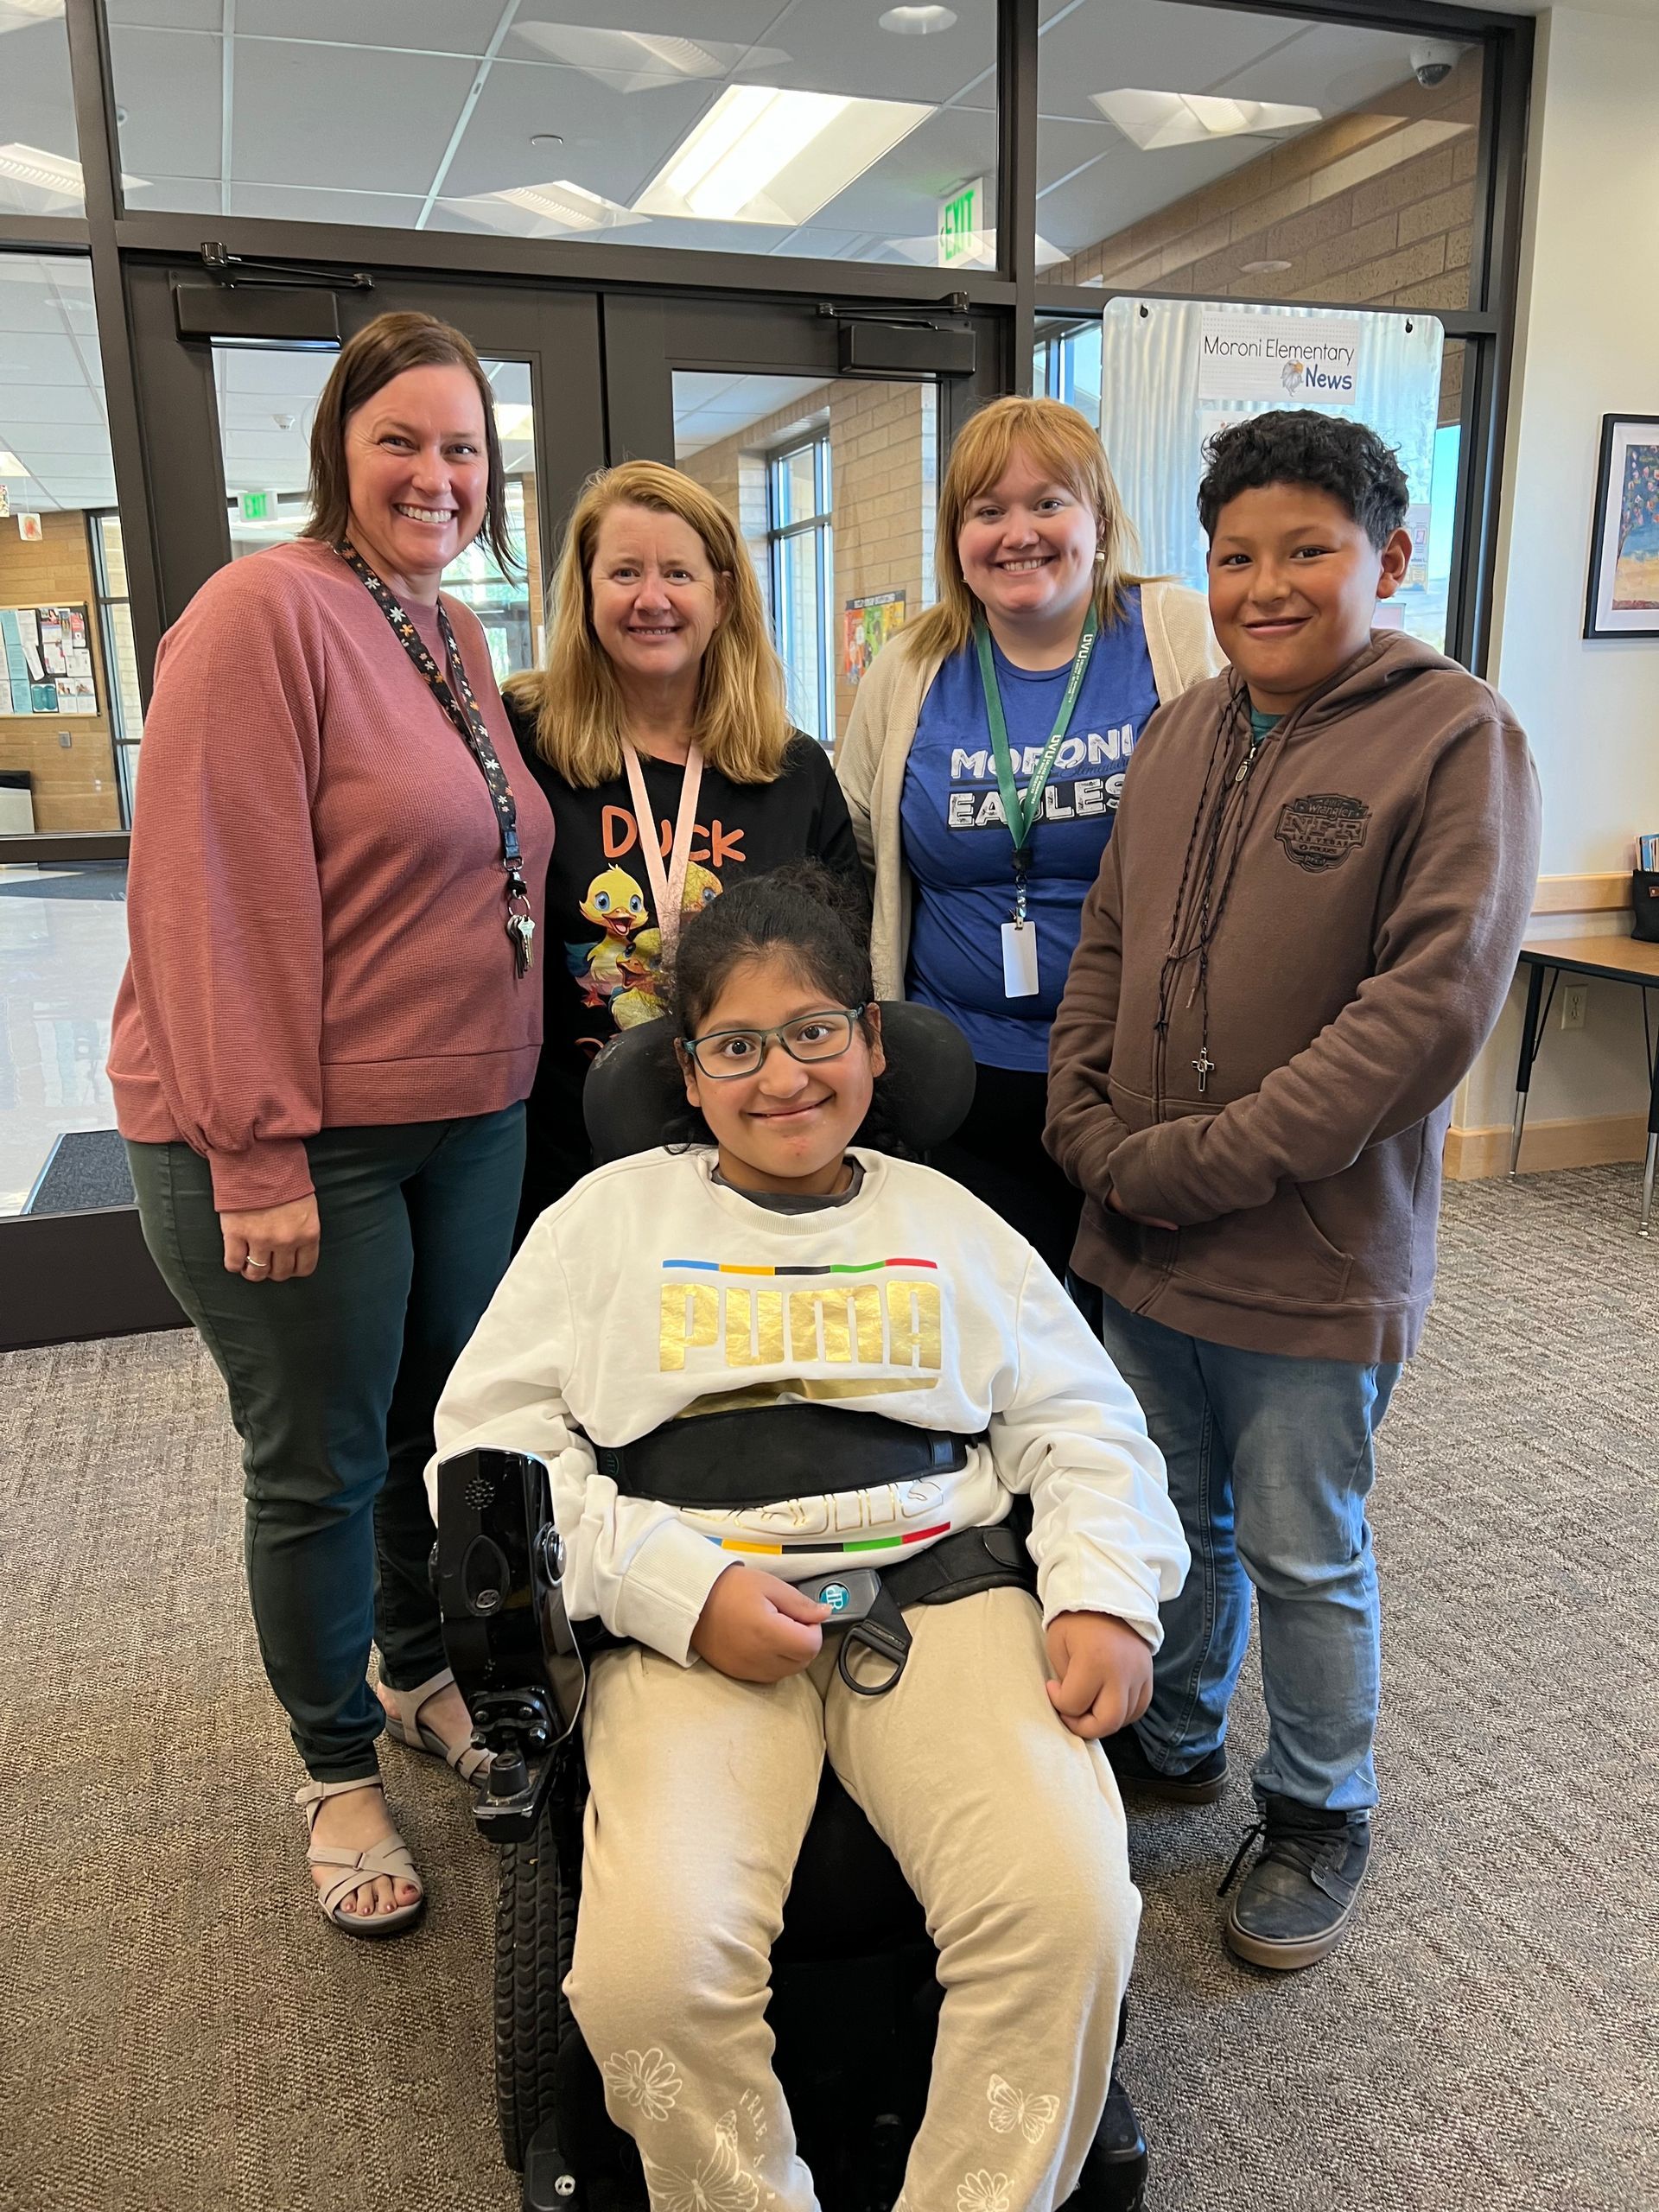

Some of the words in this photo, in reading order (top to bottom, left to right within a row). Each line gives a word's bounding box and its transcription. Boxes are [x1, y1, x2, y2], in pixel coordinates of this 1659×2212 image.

[945, 188, 975, 260] EXIT
[1204, 335, 1262, 357] Moroni
[1266, 338, 1355, 366] Elementary
[1306, 364, 1352, 390] News
[244, 493, 266, 519] EXIT
[1308, 804, 1354, 820] Wrangler
[659, 1280, 942, 1372] PUMA
